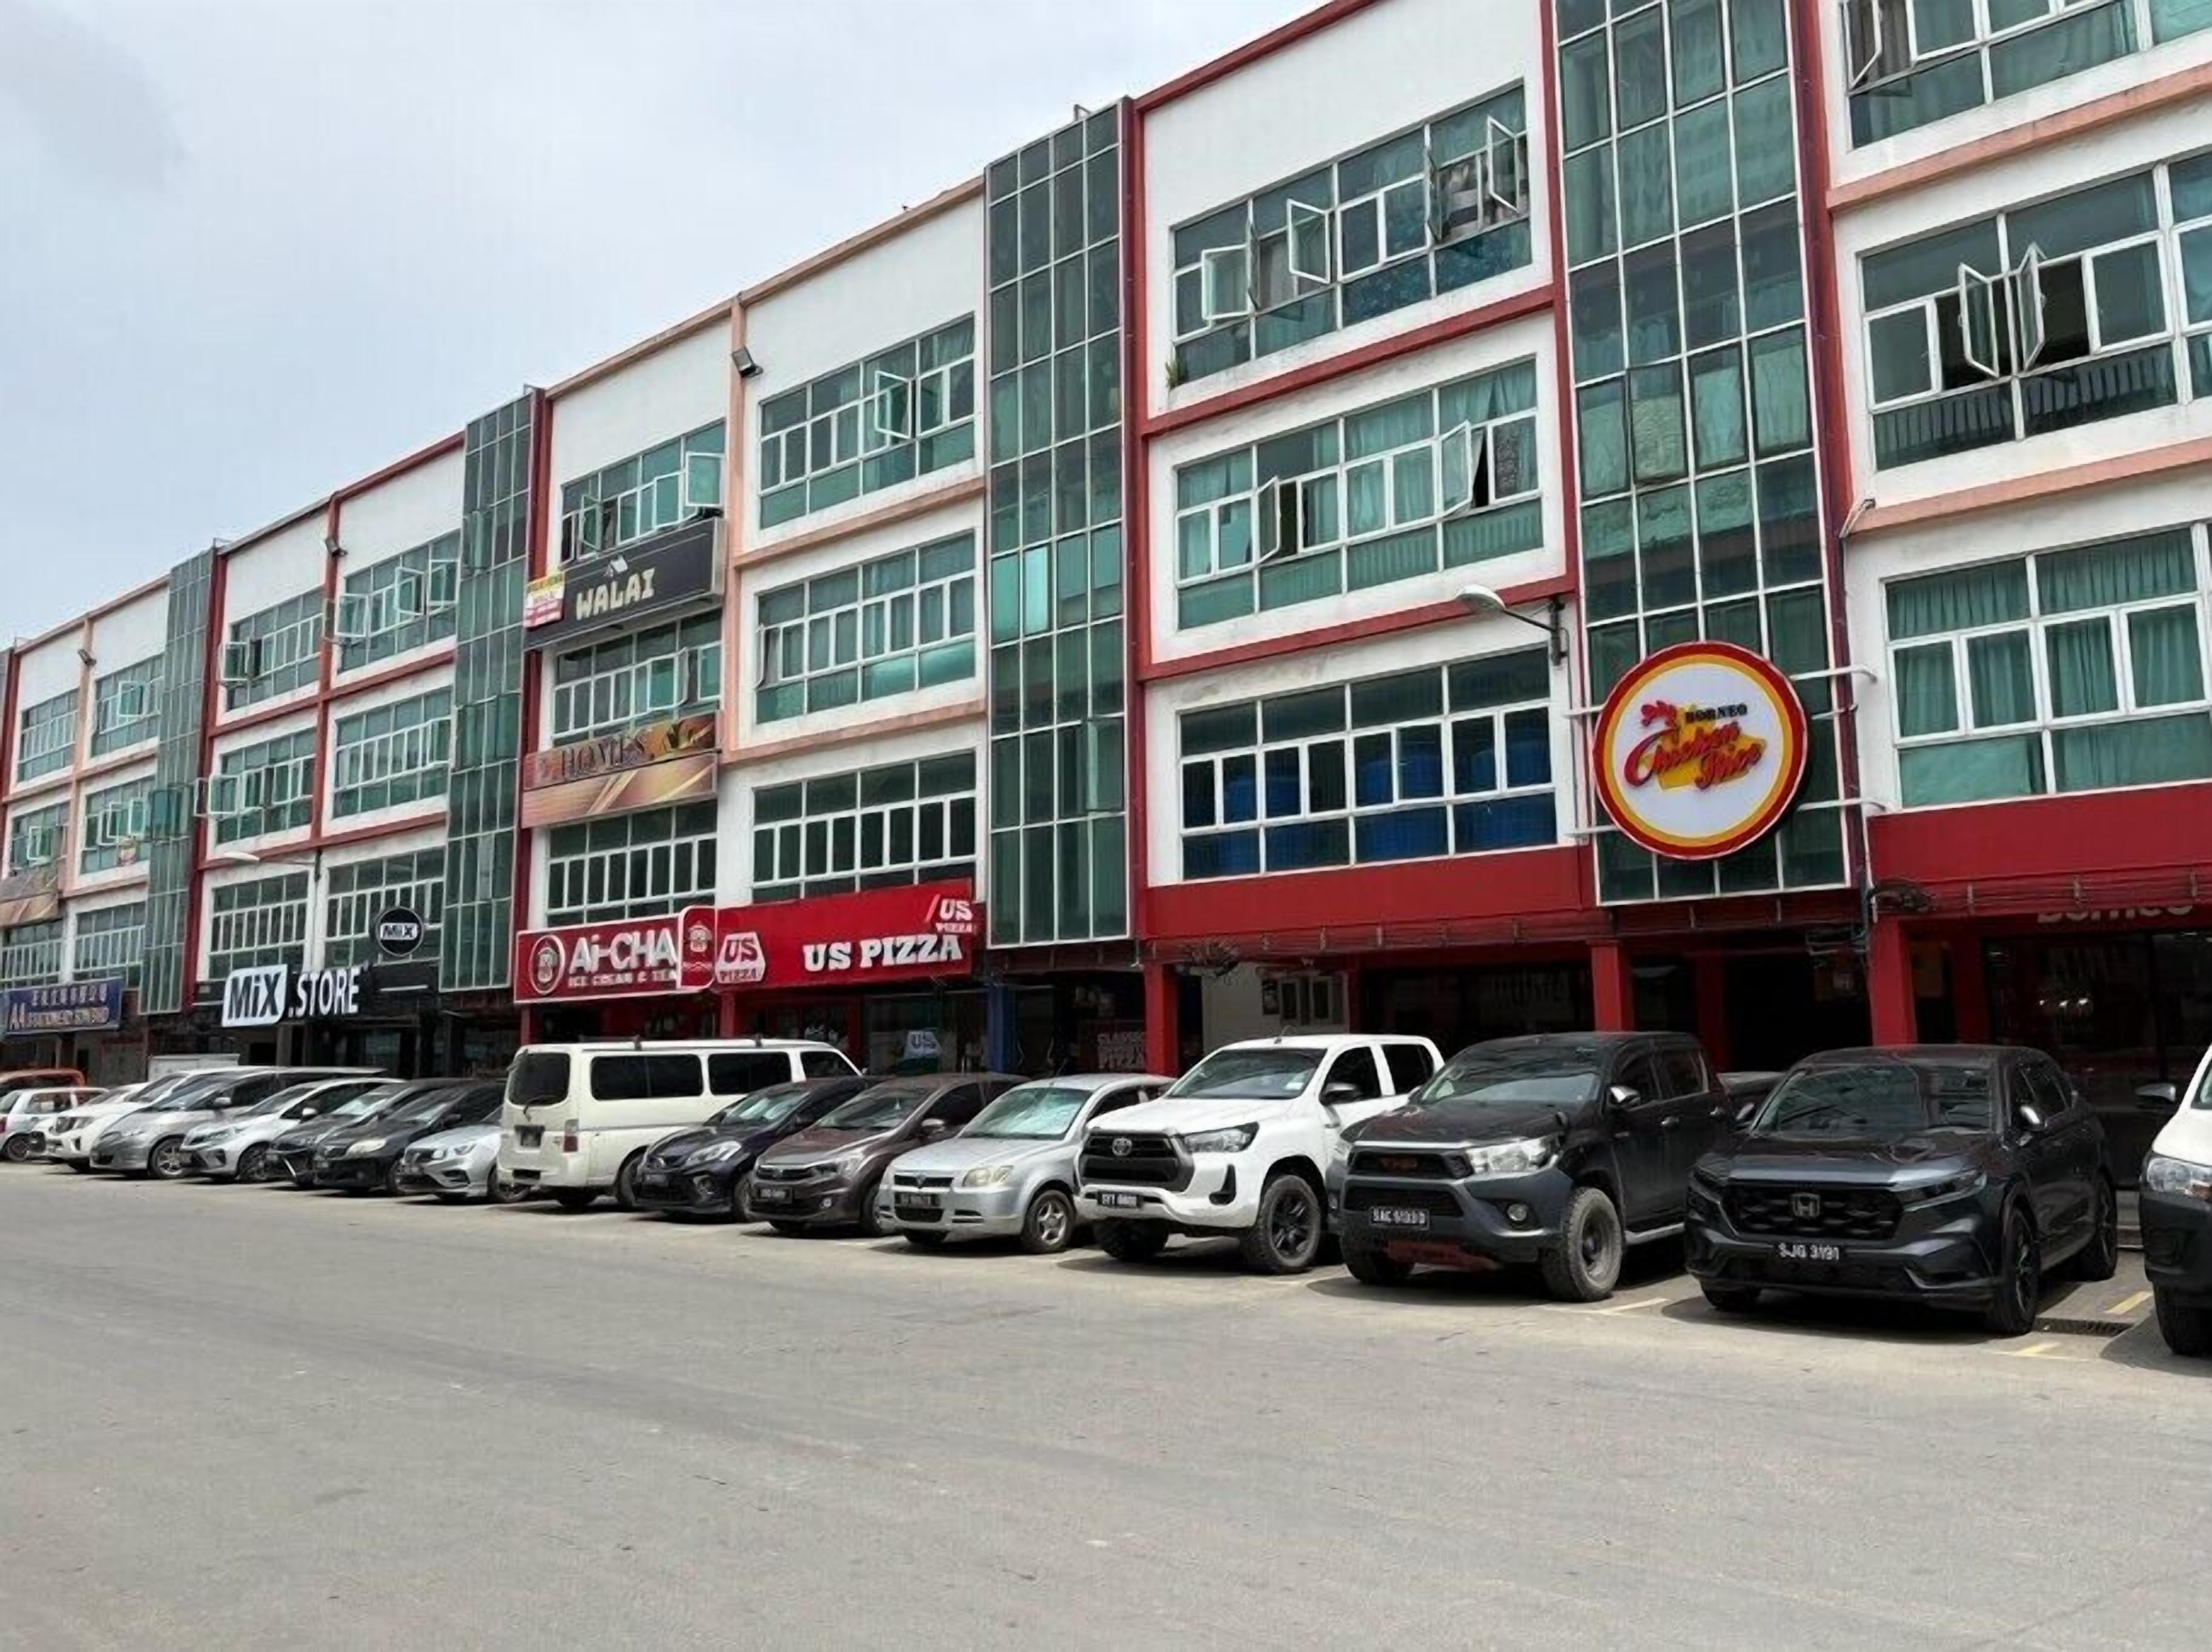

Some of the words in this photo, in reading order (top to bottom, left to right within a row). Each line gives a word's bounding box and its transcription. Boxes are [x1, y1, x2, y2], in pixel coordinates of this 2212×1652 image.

[576, 567, 655, 621] WALAI
[940, 899, 973, 920] US
[724, 937, 758, 964] US
[803, 942, 852, 971] US
[859, 934, 963, 968] PIZZA
